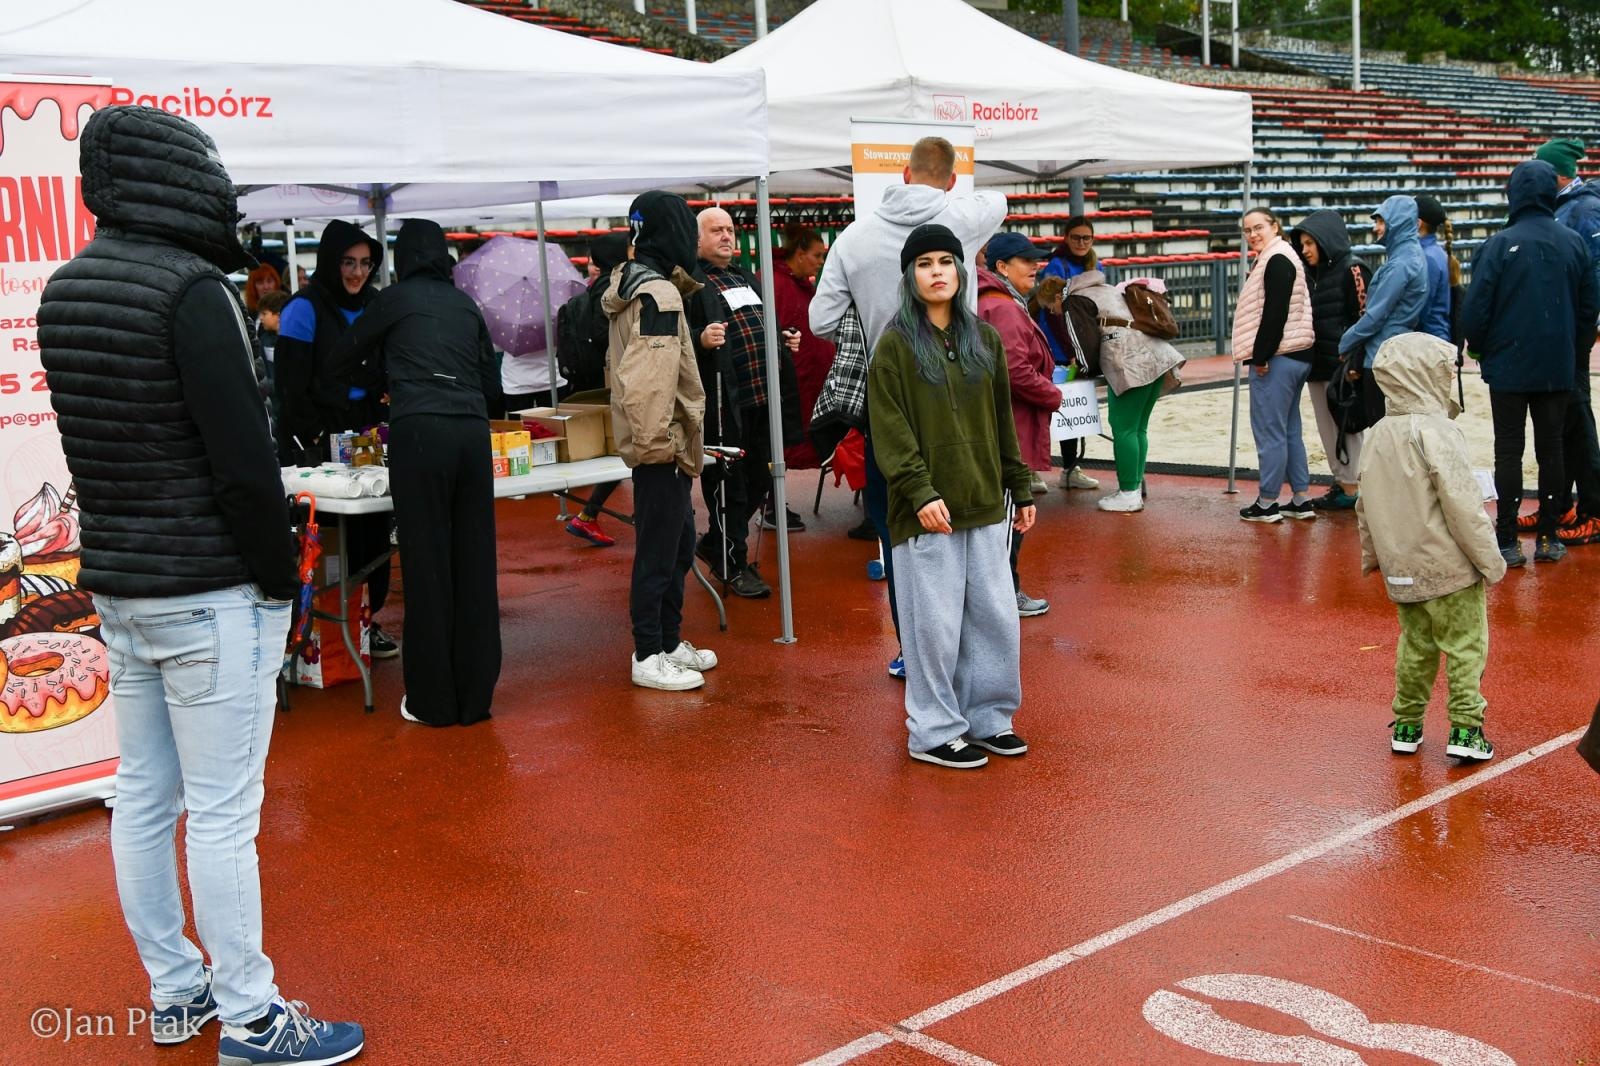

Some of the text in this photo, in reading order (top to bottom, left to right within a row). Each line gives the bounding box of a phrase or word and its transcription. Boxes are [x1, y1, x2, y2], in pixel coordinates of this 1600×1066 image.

[973, 102, 1038, 120] Racibórz
[30, 370, 50, 392] 2
[1061, 396, 1088, 408] BIURO
[1056, 412, 1099, 428] ZAWODÓW
